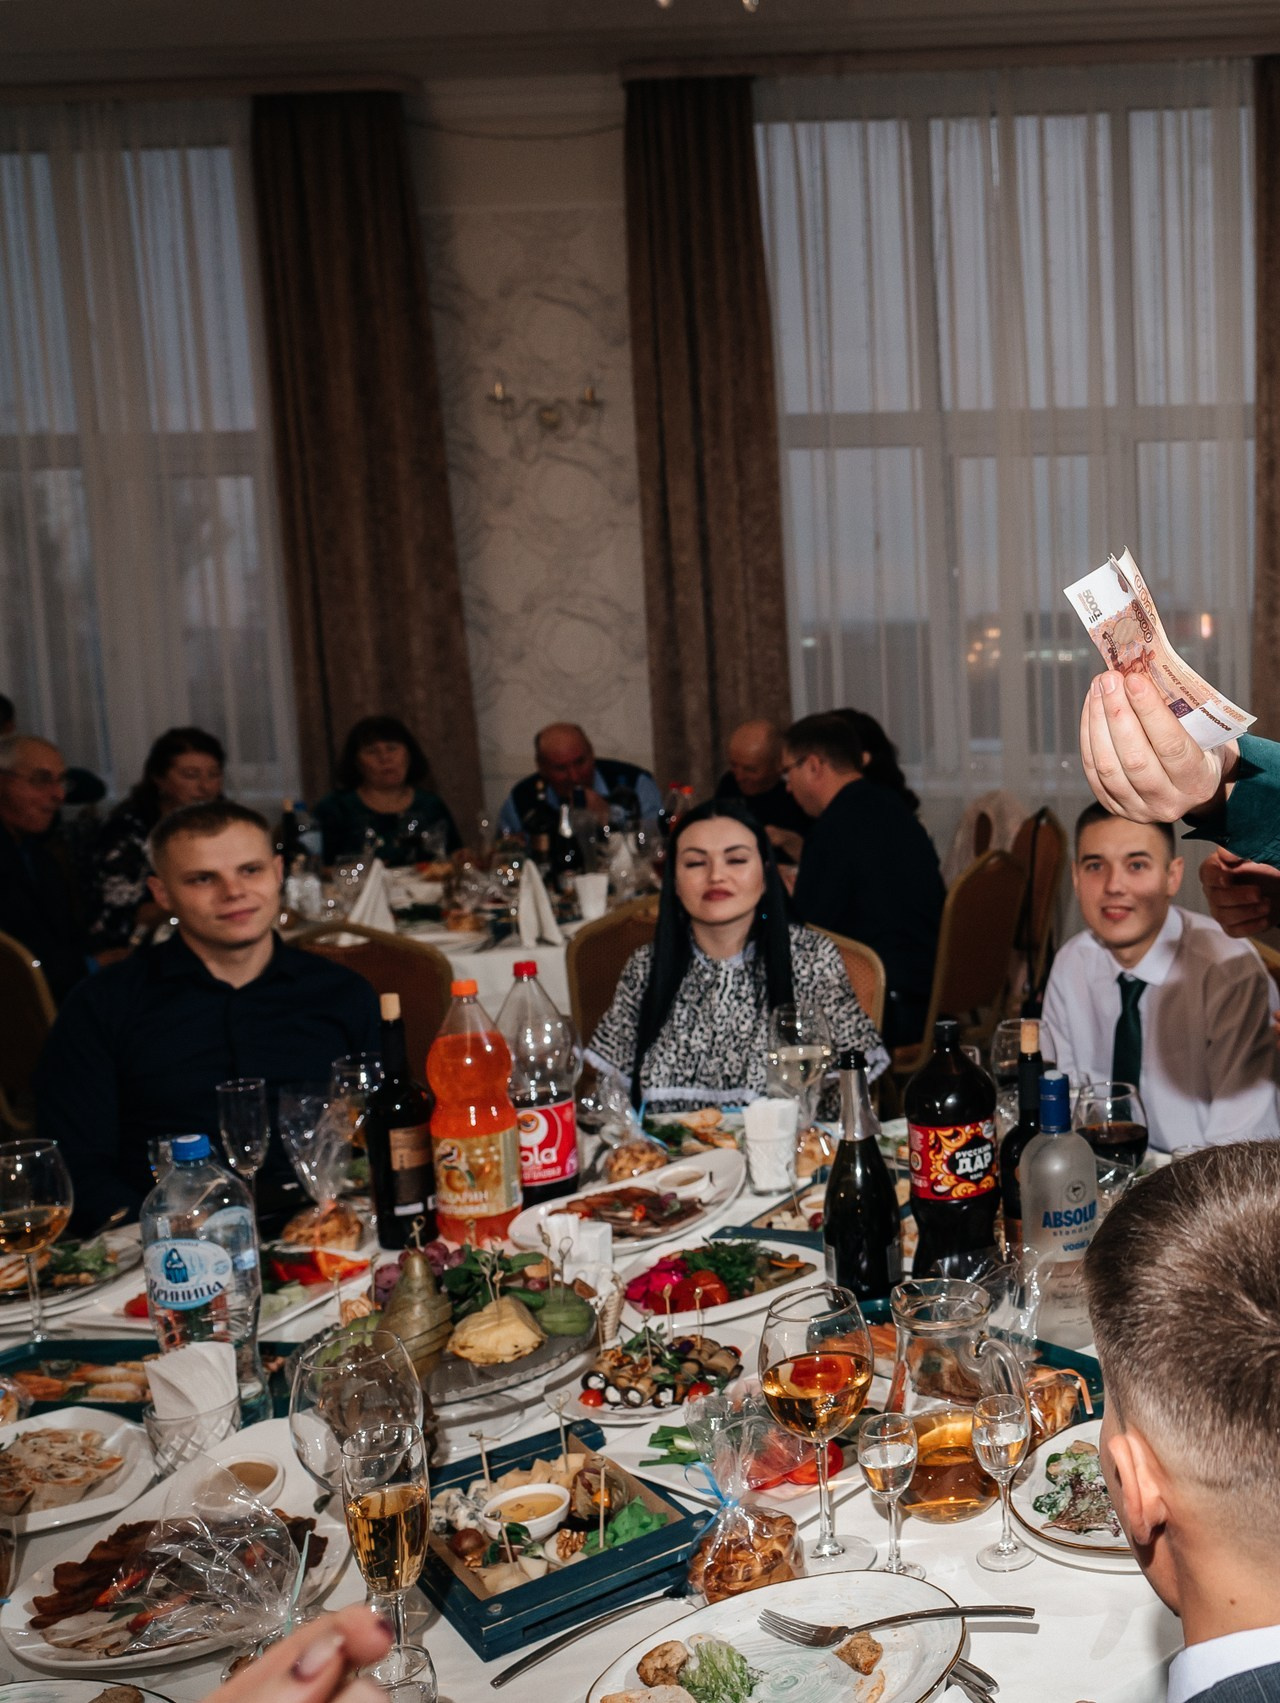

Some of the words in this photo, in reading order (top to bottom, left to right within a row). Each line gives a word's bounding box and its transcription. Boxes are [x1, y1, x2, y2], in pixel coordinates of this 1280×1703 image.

[1162, 664, 1182, 687] БИЛЕТ
[1179, 685, 1200, 707] БАНКА
[1199, 706, 1232, 732] ПРИКОЛОВ
[520, 1144, 558, 1167] ola
[956, 1151, 993, 1175] ДАР
